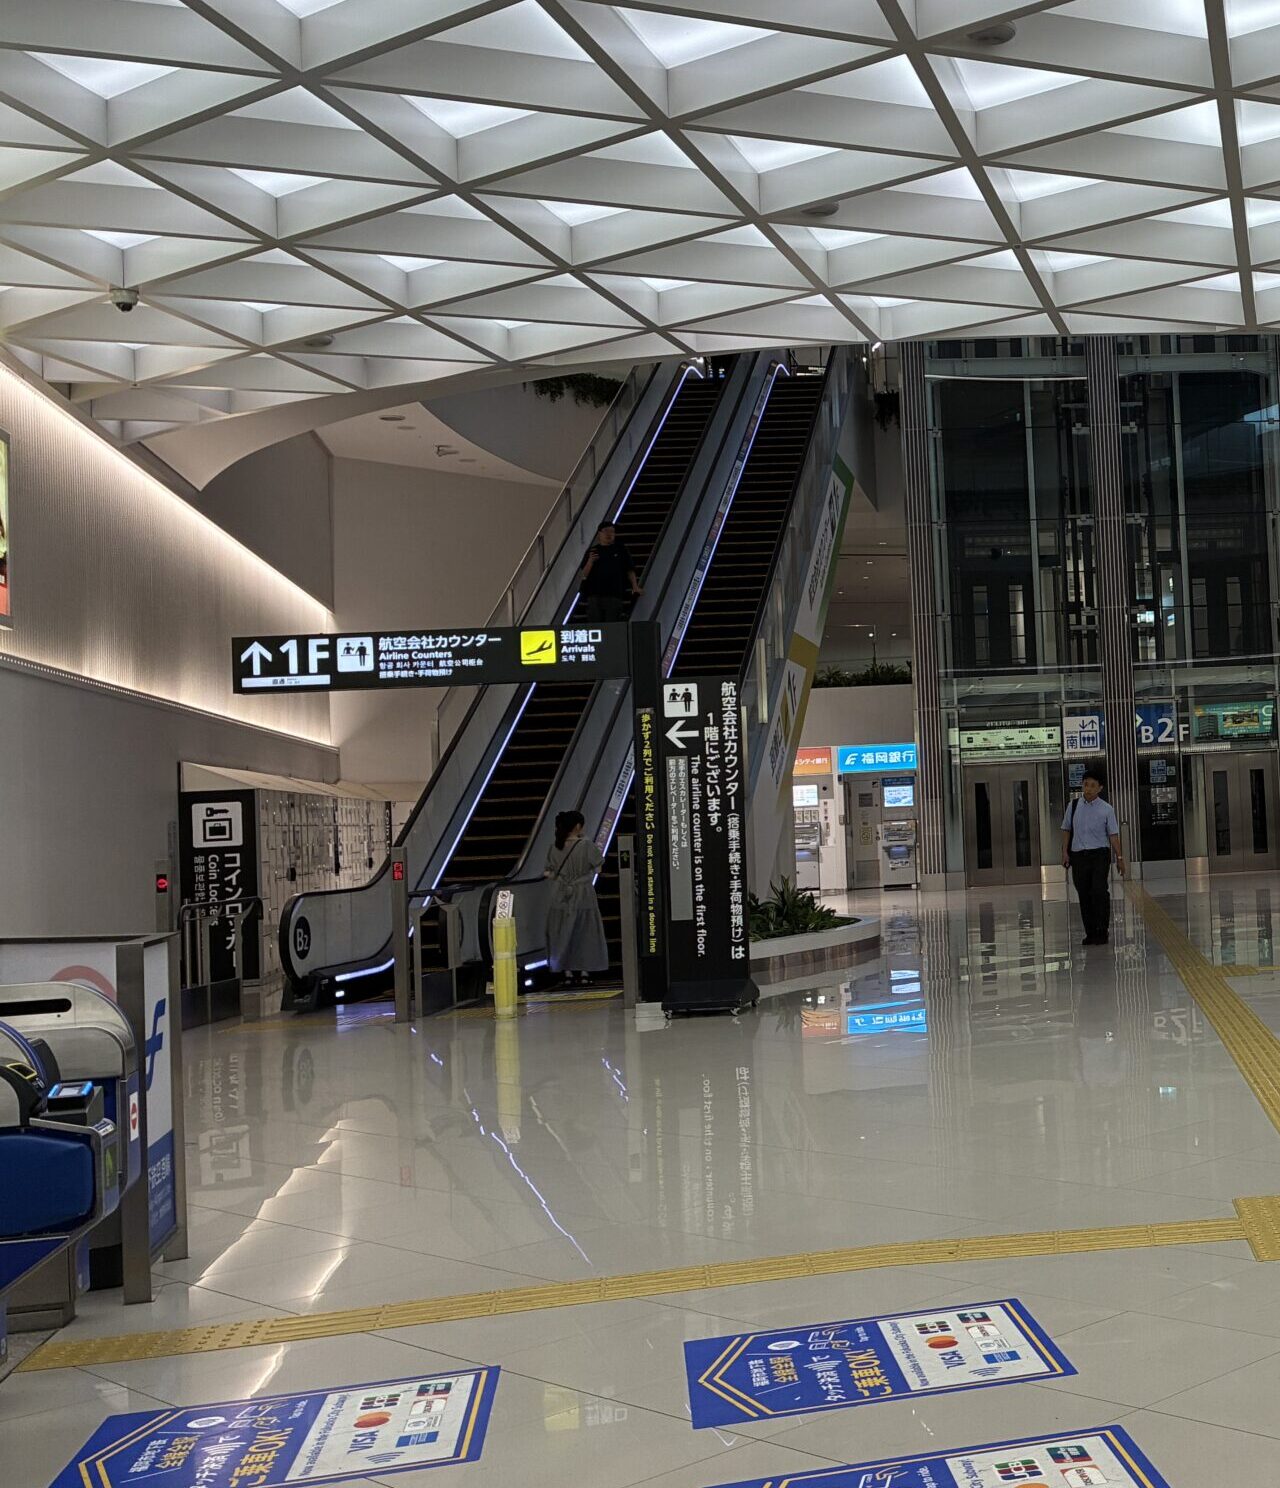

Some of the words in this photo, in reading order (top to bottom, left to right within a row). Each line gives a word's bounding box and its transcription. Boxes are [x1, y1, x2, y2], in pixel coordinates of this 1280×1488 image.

[379, 634, 501, 651] 航空会社カウンター
[561, 629, 602, 644] 到着口
[279, 638, 330, 675] 1F
[379, 652, 409, 660] Airline
[411, 651, 453, 659] Counters
[561, 644, 595, 653] Arrivals
[1141, 717, 1190, 743] B2F
[1066, 735, 1077, 750] 南
[691, 755, 700, 775] The
[861, 750, 915, 765] 福岡銀行
[640, 713, 656, 830] 歩かず2列でご利用ください
[704, 712, 722, 833] 1階にございます。
[692, 779, 702, 810] airline
[692, 813, 703, 853] counter
[208, 854, 220, 880] Coin
[694, 855, 704, 864] is
[694, 867, 703, 881] on
[695, 884, 706, 902] the
[696, 905, 707, 926] first
[296, 929, 309, 949] B2
[696, 929, 708, 957] floor.
[937, 1350, 968, 1369] VISA
[842, 1348, 895, 1397] ご乗車OK!
[346, 1430, 380, 1454] VISA
[226, 1427, 293, 1488] ご乗車OK!
